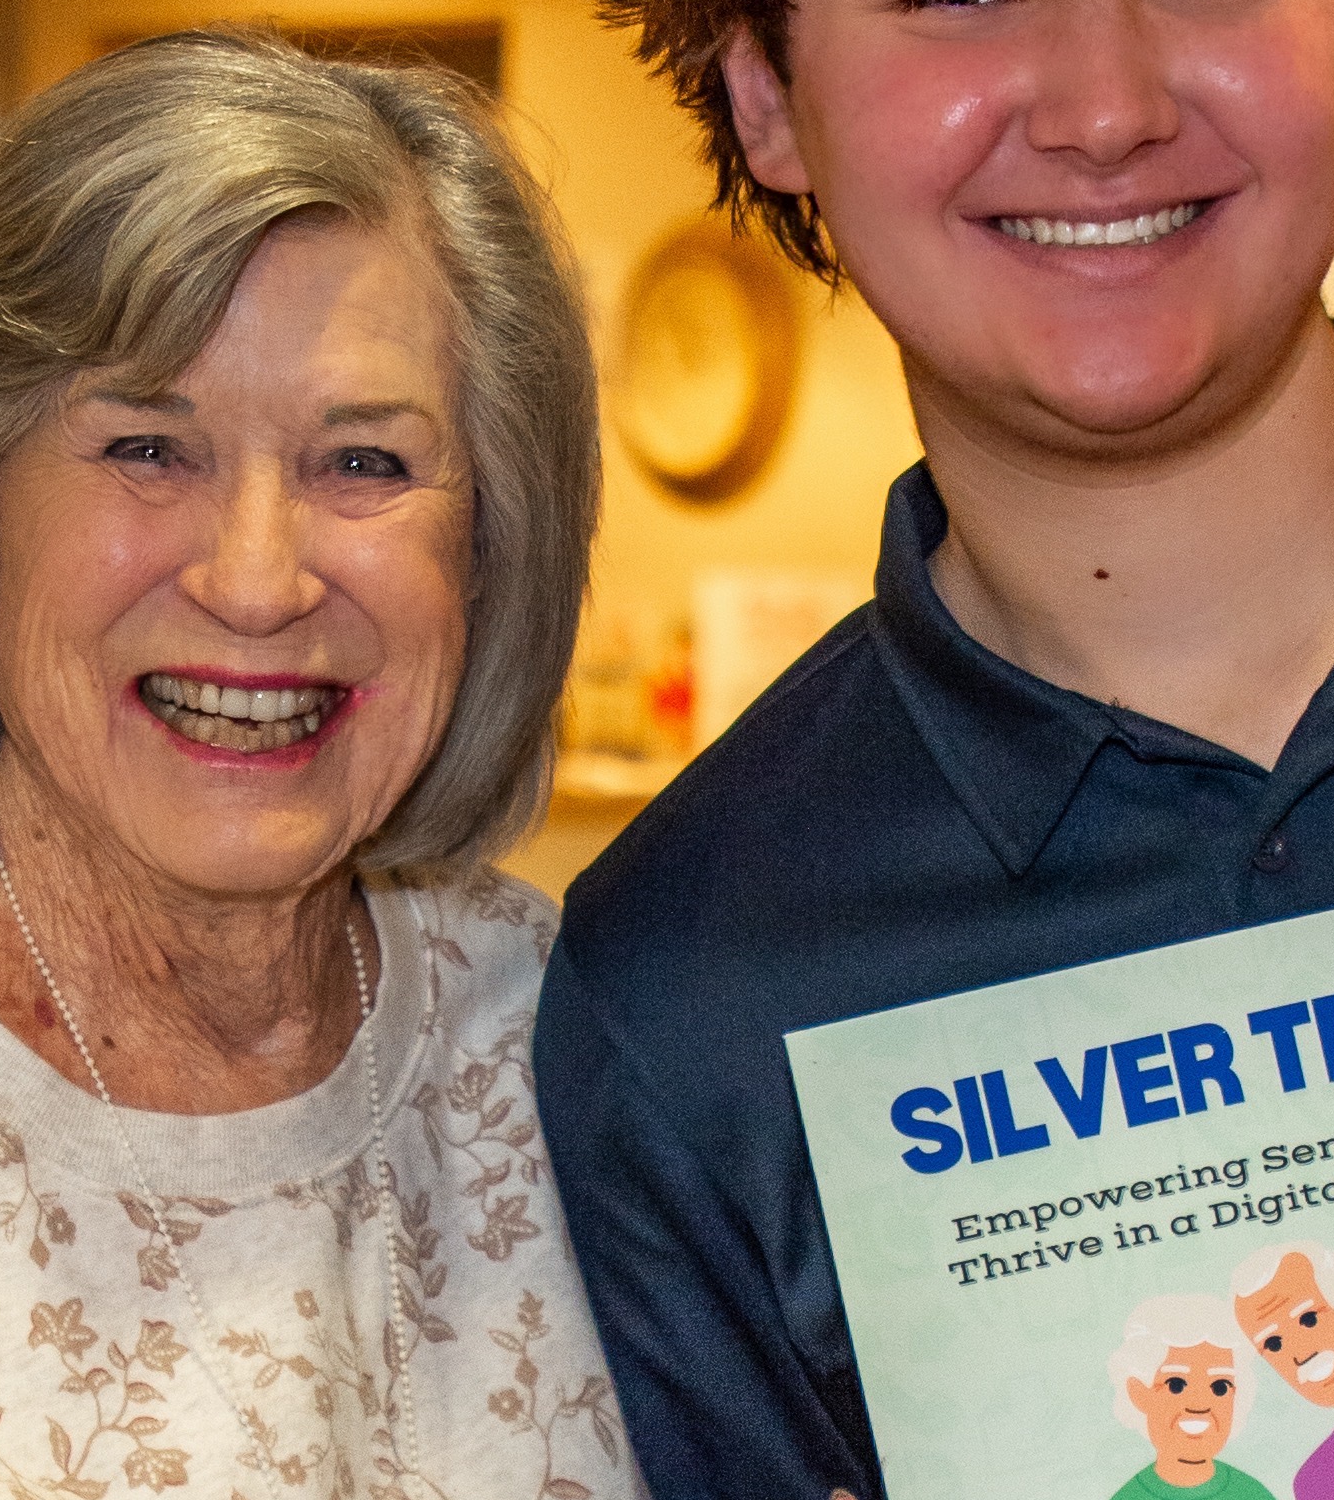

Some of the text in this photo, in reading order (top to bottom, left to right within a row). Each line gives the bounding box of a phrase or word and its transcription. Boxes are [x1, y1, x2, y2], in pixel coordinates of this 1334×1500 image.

[889, 1022, 1246, 1175] SILVER
[951, 1158, 1251, 1243] Empowering
[948, 1230, 1104, 1287] Thrive
[1114, 1222, 1161, 1251] in
[1170, 1213, 1200, 1238] a
